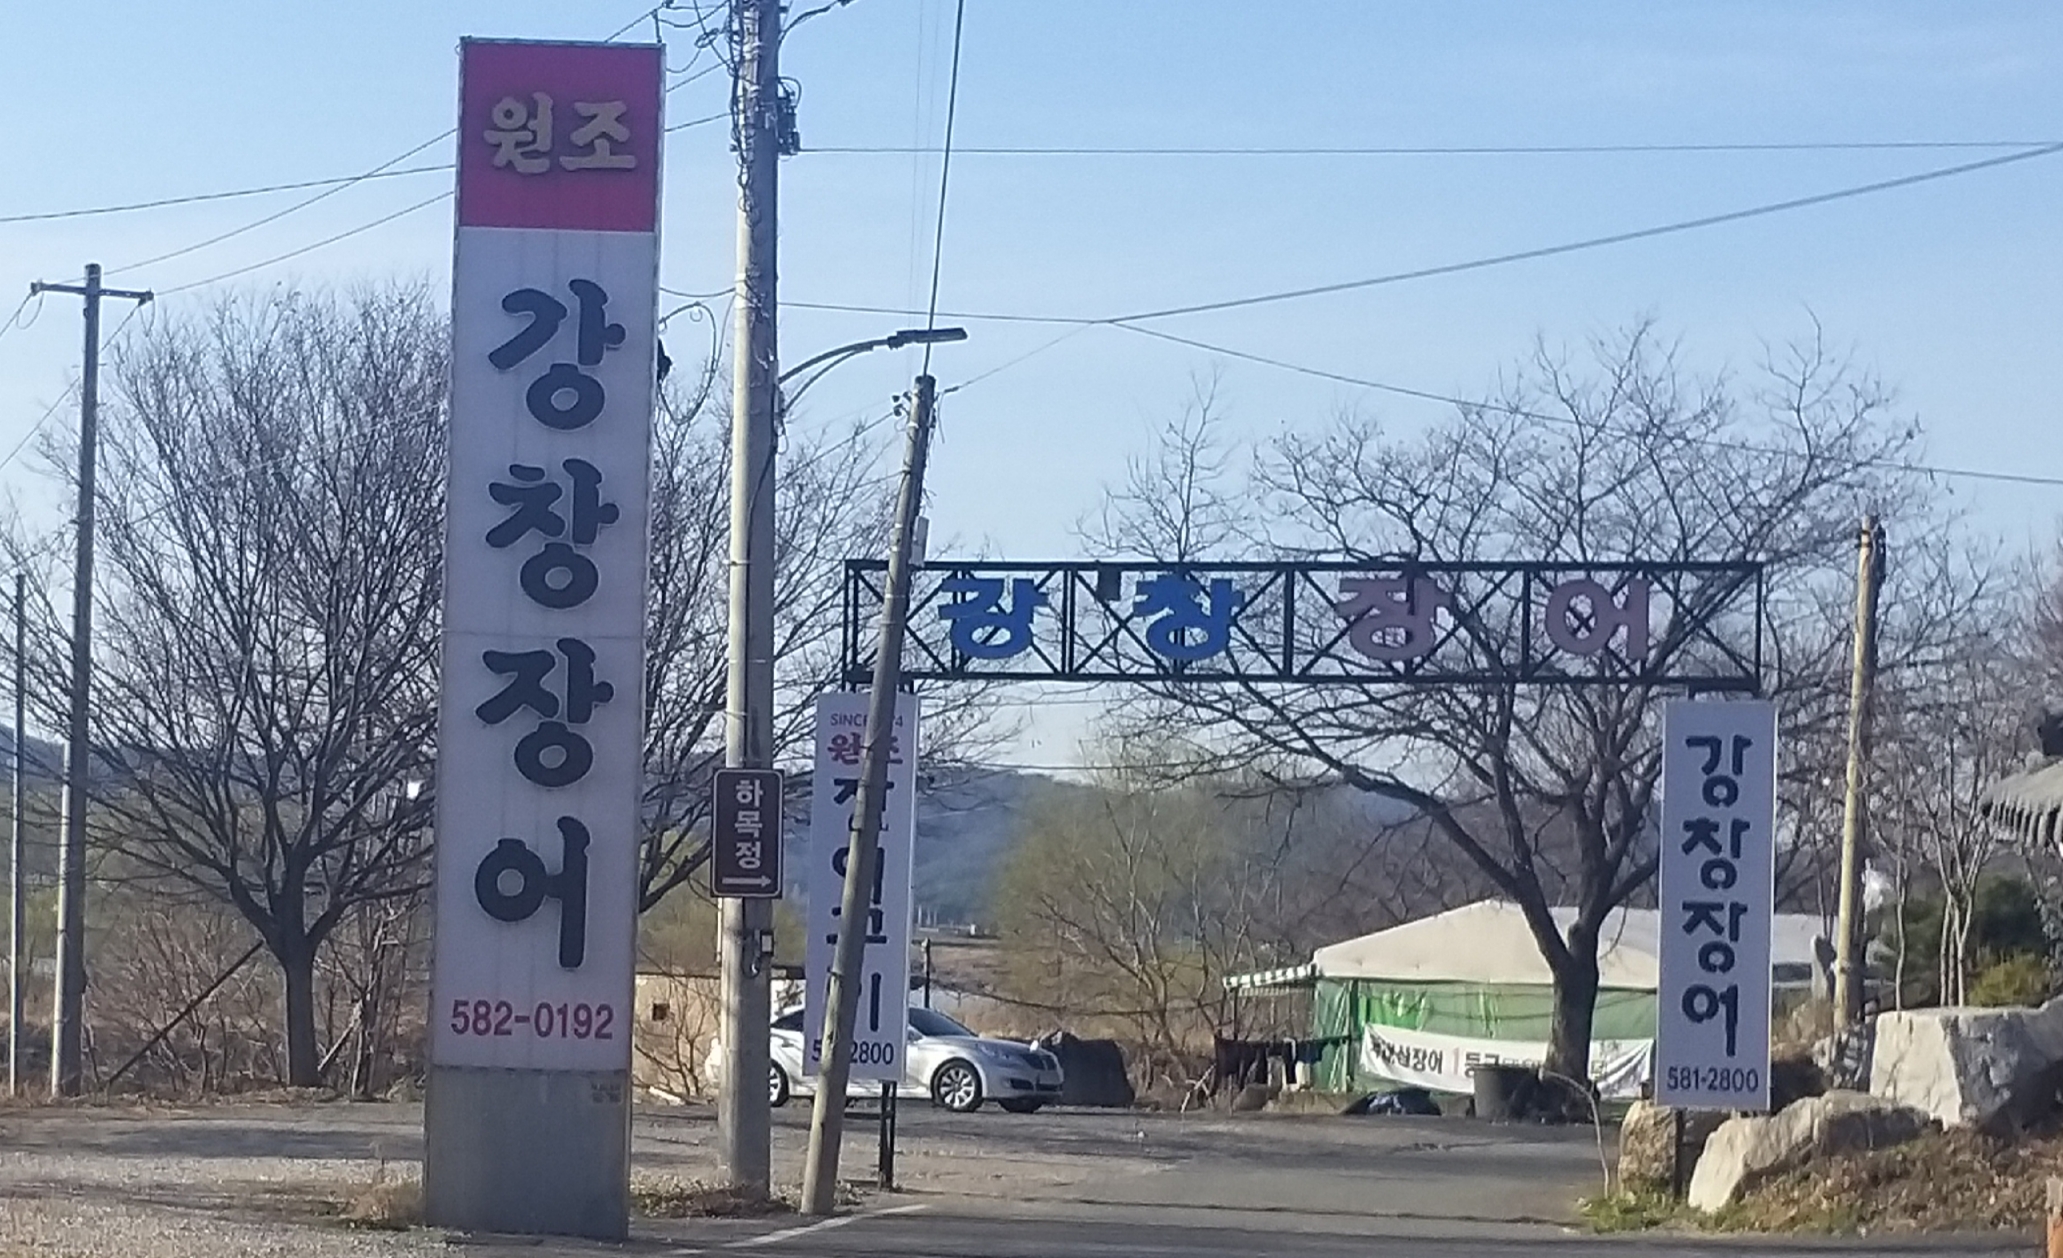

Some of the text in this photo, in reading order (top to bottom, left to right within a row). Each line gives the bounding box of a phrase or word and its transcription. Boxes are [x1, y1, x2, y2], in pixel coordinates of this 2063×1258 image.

[483, 91, 638, 175] 원조
[474, 278, 627, 969] 강창장어
[937, 572, 1651, 662] 강창장어
[734, 779, 764, 869] 하목정
[1681, 734, 1754, 1058] 강창장어
[450, 999, 615, 1040] 582-0192
[811, 1039, 895, 1065] 52800
[1666, 1066, 1760, 1094] 581-2800
